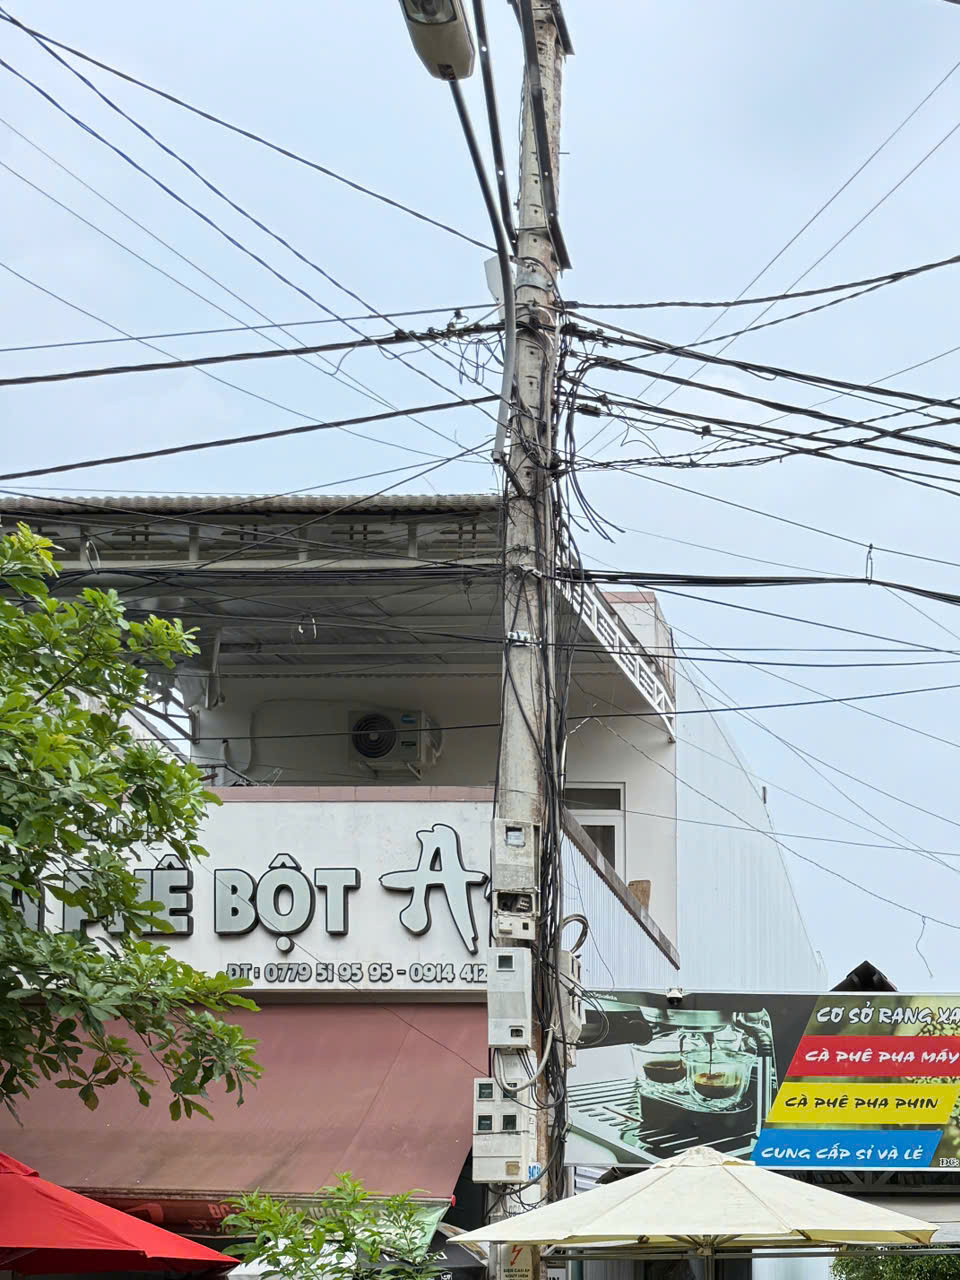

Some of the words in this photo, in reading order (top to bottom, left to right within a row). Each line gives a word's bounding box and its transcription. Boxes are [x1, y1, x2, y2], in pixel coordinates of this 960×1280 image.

[214, 853, 361, 954] BỘT
[264, 963, 312, 984] 0779
[315, 963, 335, 983] 51
[338, 963, 364, 983] 95
[368, 963, 394, 984] 95
[409, 963, 456, 984] 0914
[816, 1007, 844, 1023] CƠ
[849, 1001, 874, 1024] SỞ
[878, 1008, 934, 1025] RANG
[805, 1048, 830, 1062] CÀ
[836, 1048, 873, 1062] PHÊ
[878, 1051, 915, 1062] PHA
[921, 1049, 960, 1064] MÁY
[785, 1094, 808, 1108] CÀ
[814, 1094, 848, 1108] PHÊ
[855, 1098, 889, 1108] PHA
[895, 1098, 939, 1109] PHIN
[761, 1148, 810, 1160] CUNG
[816, 1143, 851, 1160] CẤP
[877, 1146, 899, 1160] VÀ
